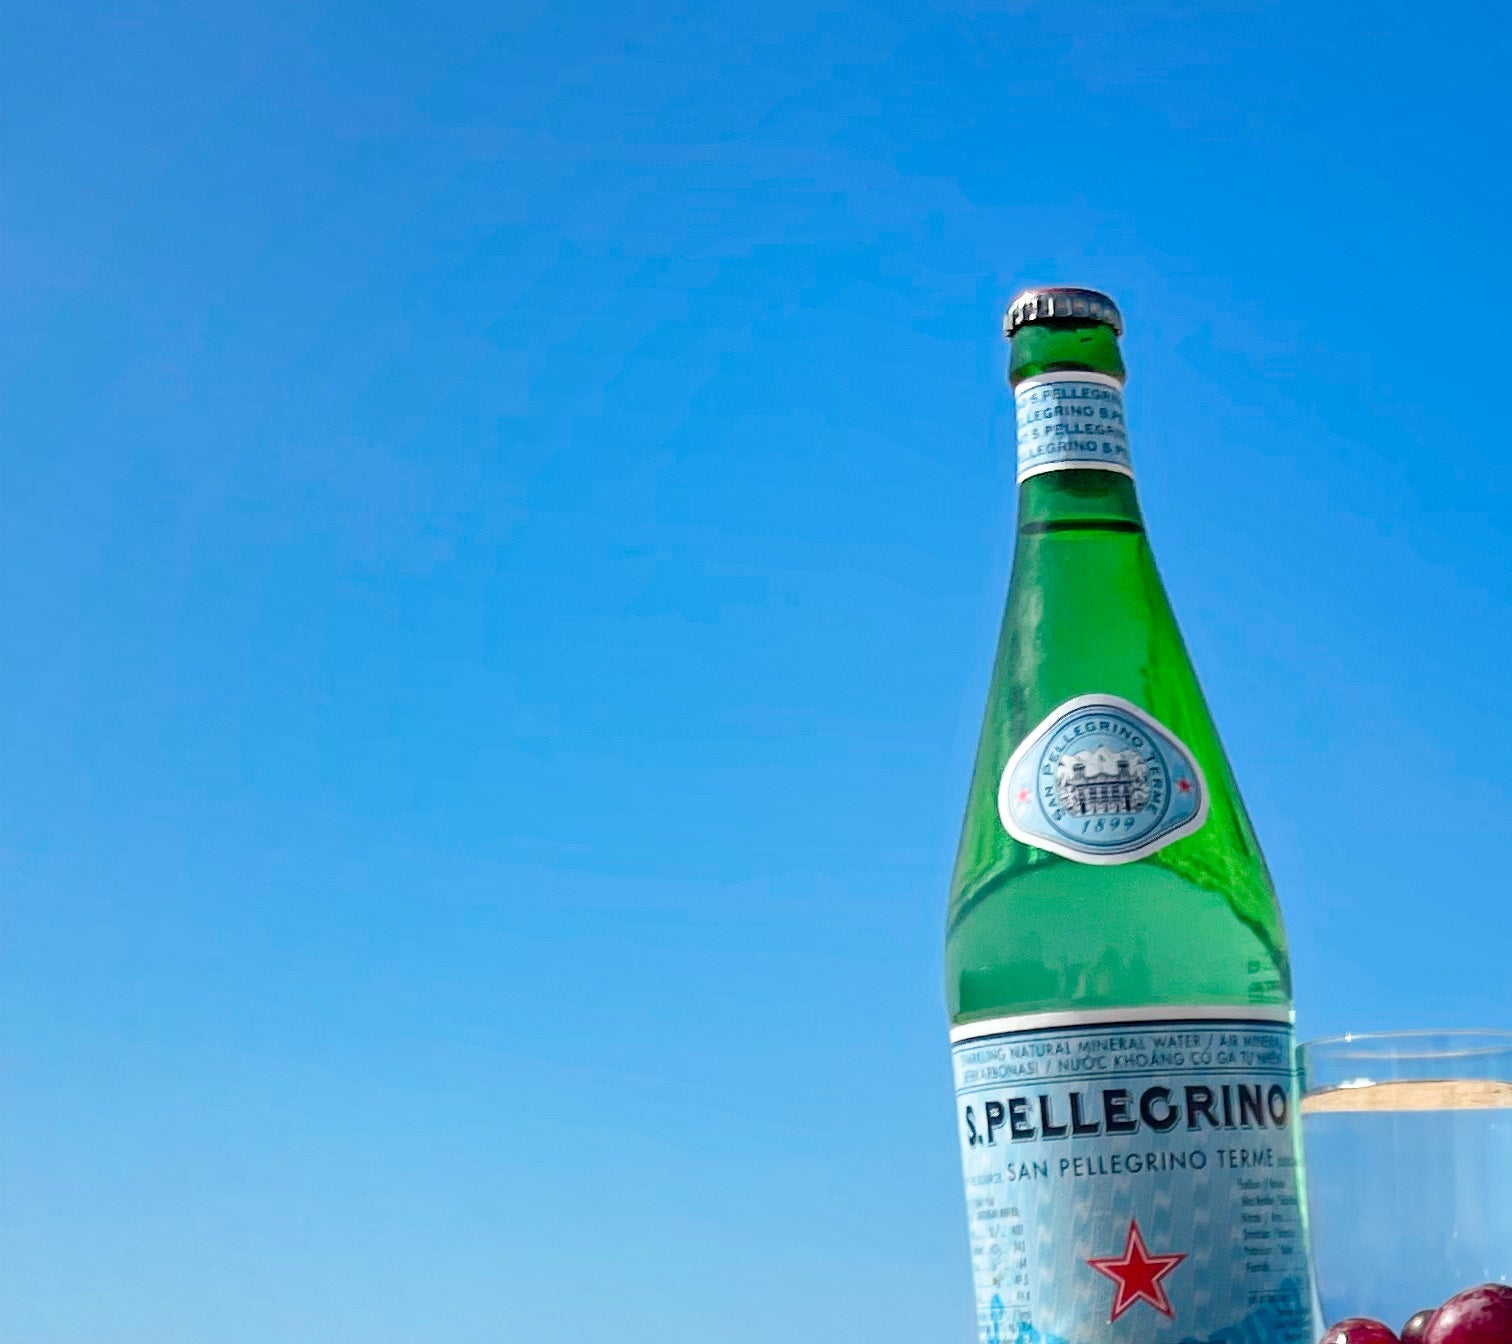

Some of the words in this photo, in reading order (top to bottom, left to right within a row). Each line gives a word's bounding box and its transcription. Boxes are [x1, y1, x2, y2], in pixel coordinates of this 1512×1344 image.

[1043, 721, 1144, 776] PELLEGRINO
[1045, 786, 1066, 821] SAN
[1082, 817, 1135, 834] 1899
[1010, 1041, 1070, 1058] NATURAL
[1078, 1036, 1146, 1053] MINERAL
[1152, 1034, 1200, 1049] WATER
[966, 1084, 1287, 1148] S.PELLEGRINO
[1007, 1160, 1048, 1182] SAN
[1059, 1149, 1207, 1178] PELLEGRINO
[1216, 1148, 1274, 1168] TERME
